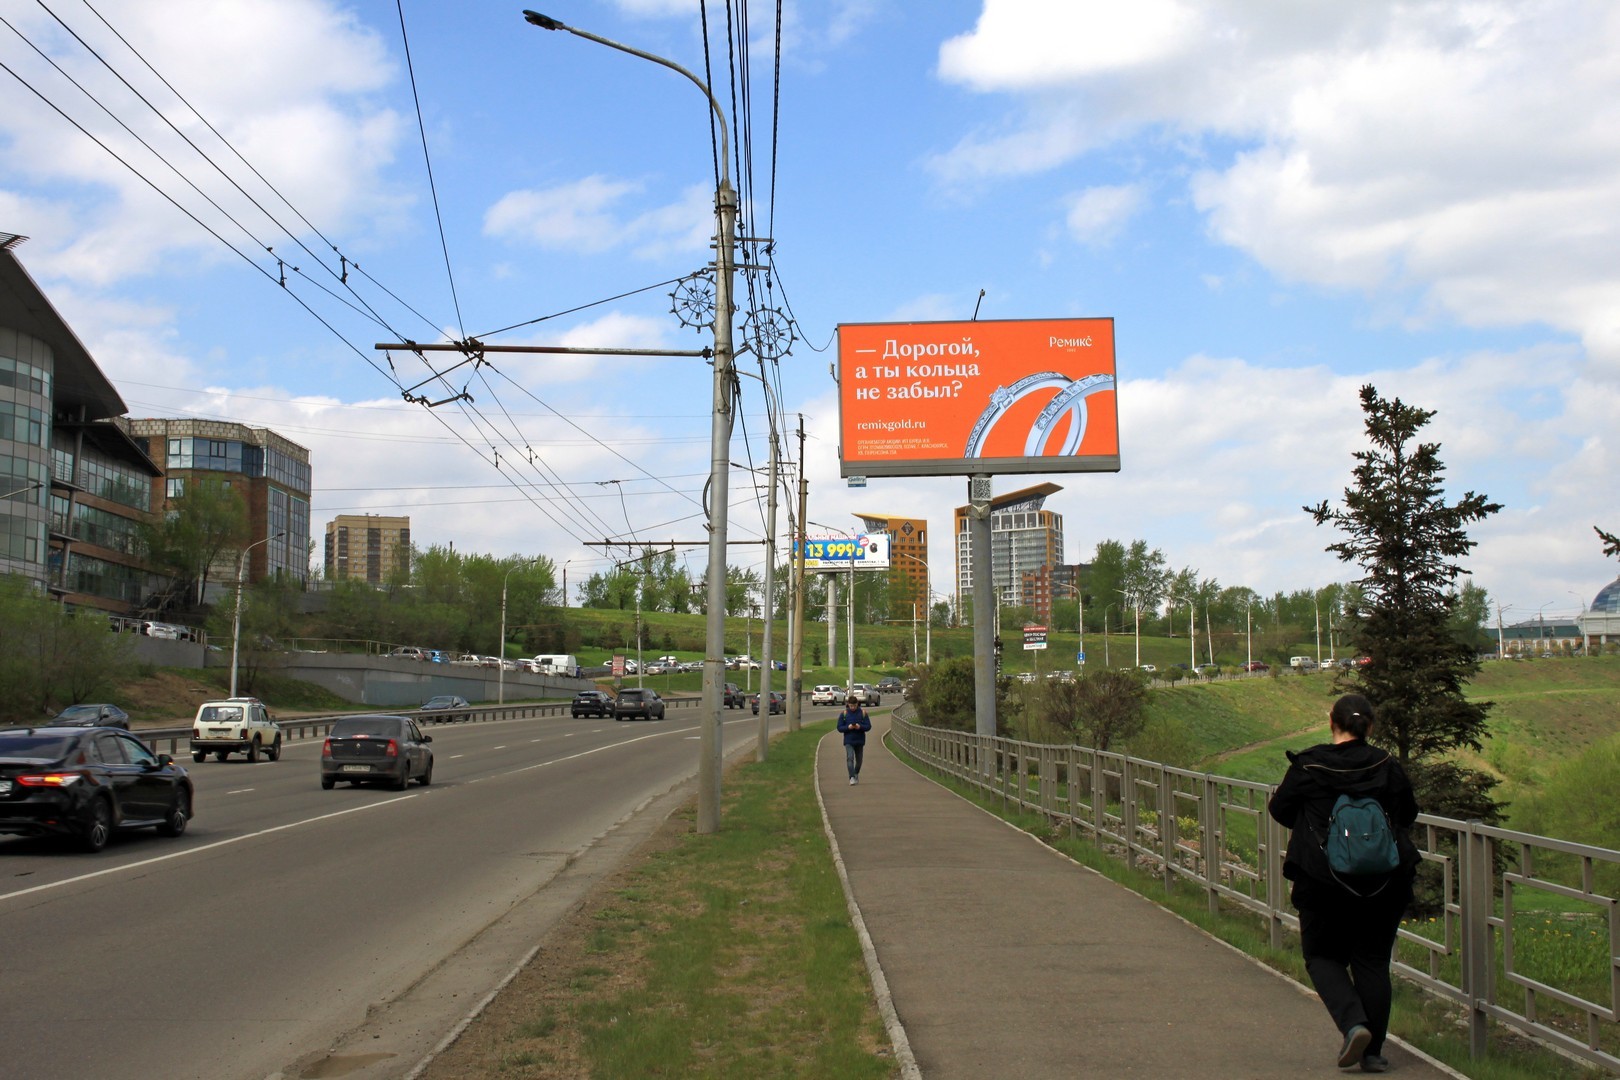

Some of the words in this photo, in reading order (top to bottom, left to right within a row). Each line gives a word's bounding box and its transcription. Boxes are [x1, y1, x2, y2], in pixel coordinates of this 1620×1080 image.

[882, 337, 980, 361] Дорогой,
[855, 366, 868, 379] а
[872, 365, 900, 378] ты
[906, 363, 981, 379] кольца
[856, 387, 881, 400] не
[887, 380, 963, 399] забыл?
[857, 419, 926, 432] remixgold.ru
[807, 543, 824, 558] 13
[827, 543, 856, 557] 999
